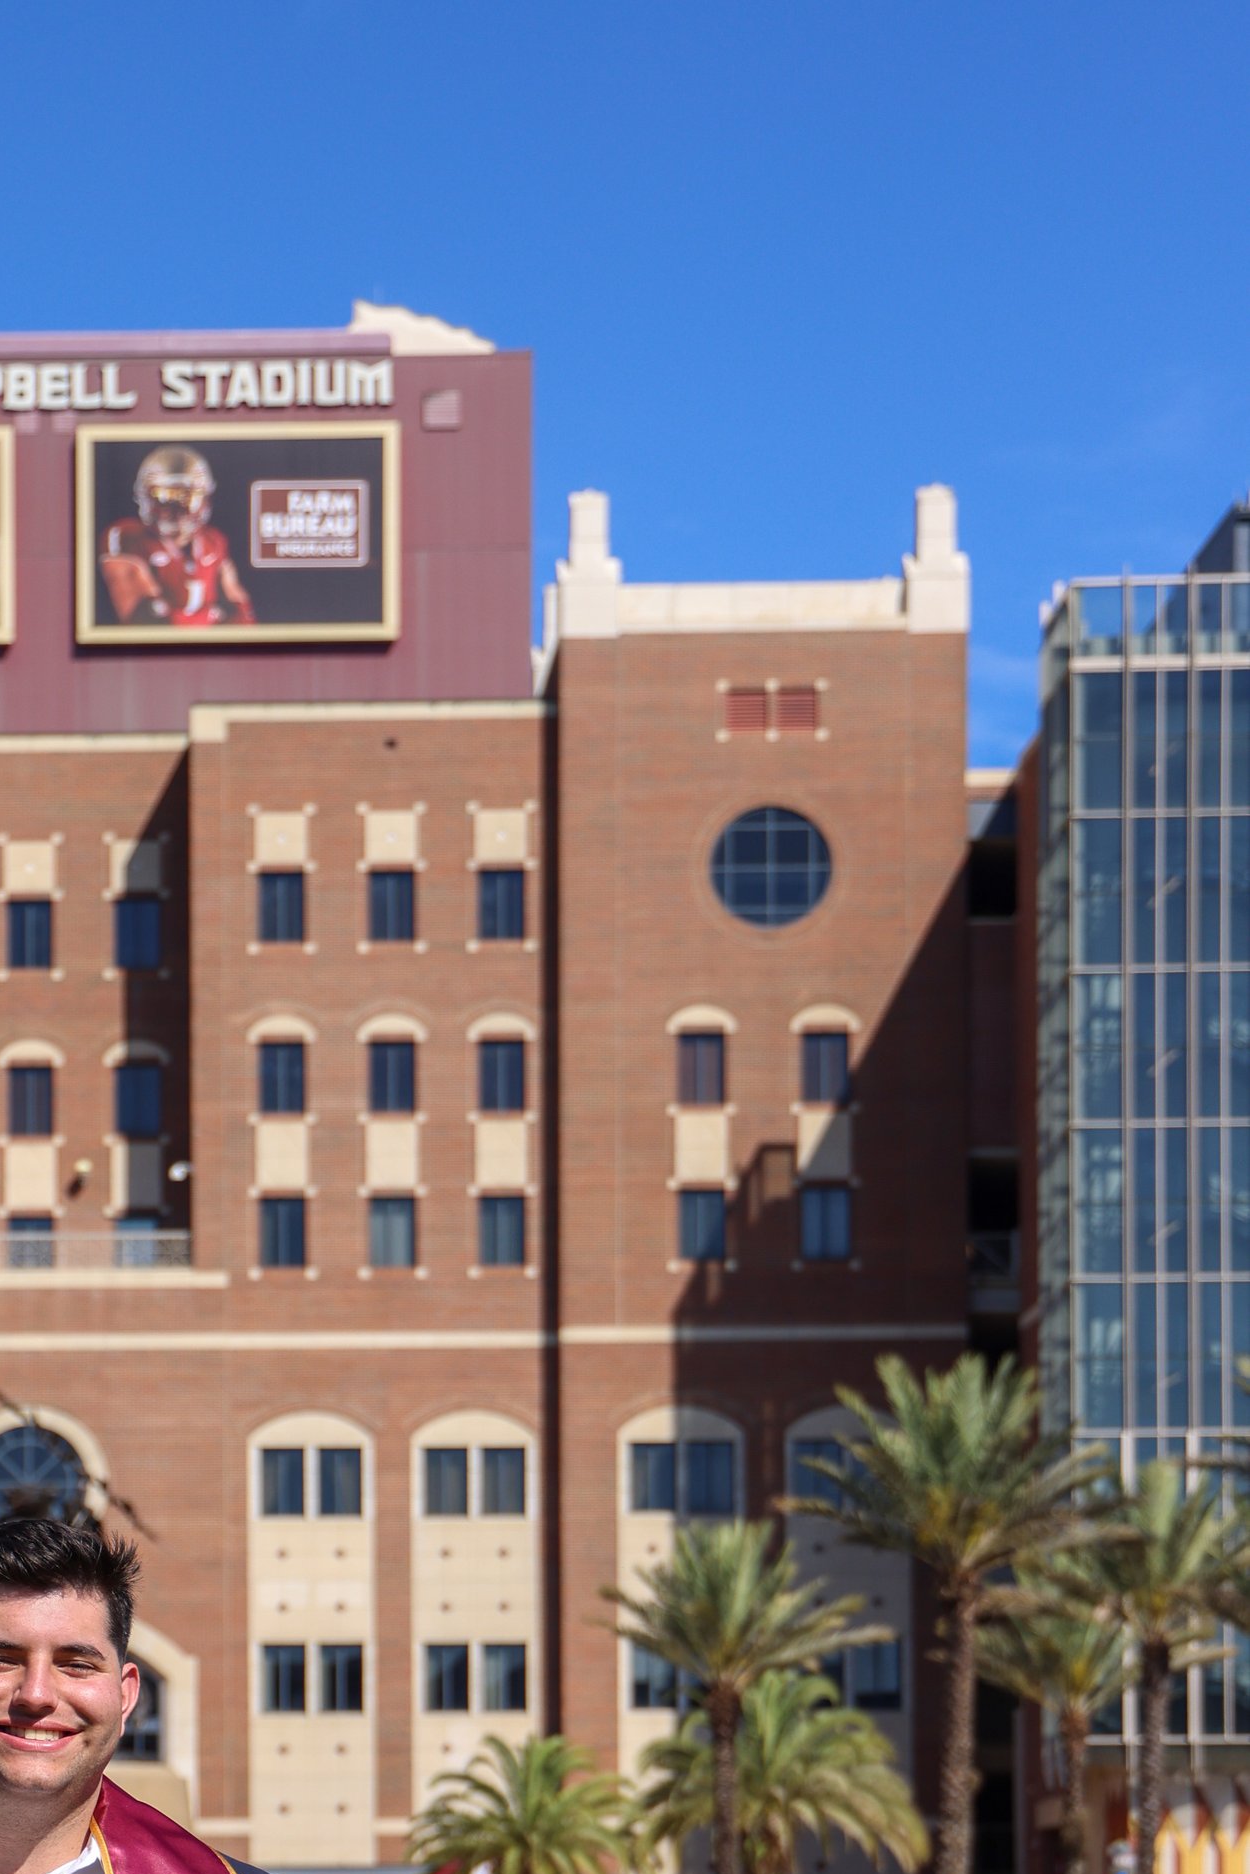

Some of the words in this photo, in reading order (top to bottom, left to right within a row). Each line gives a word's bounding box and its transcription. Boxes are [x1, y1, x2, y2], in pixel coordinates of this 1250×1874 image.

[161, 358, 394, 409] STADIUM
[287, 490, 356, 514] FARM
[259, 512, 357, 538] BUREAU
